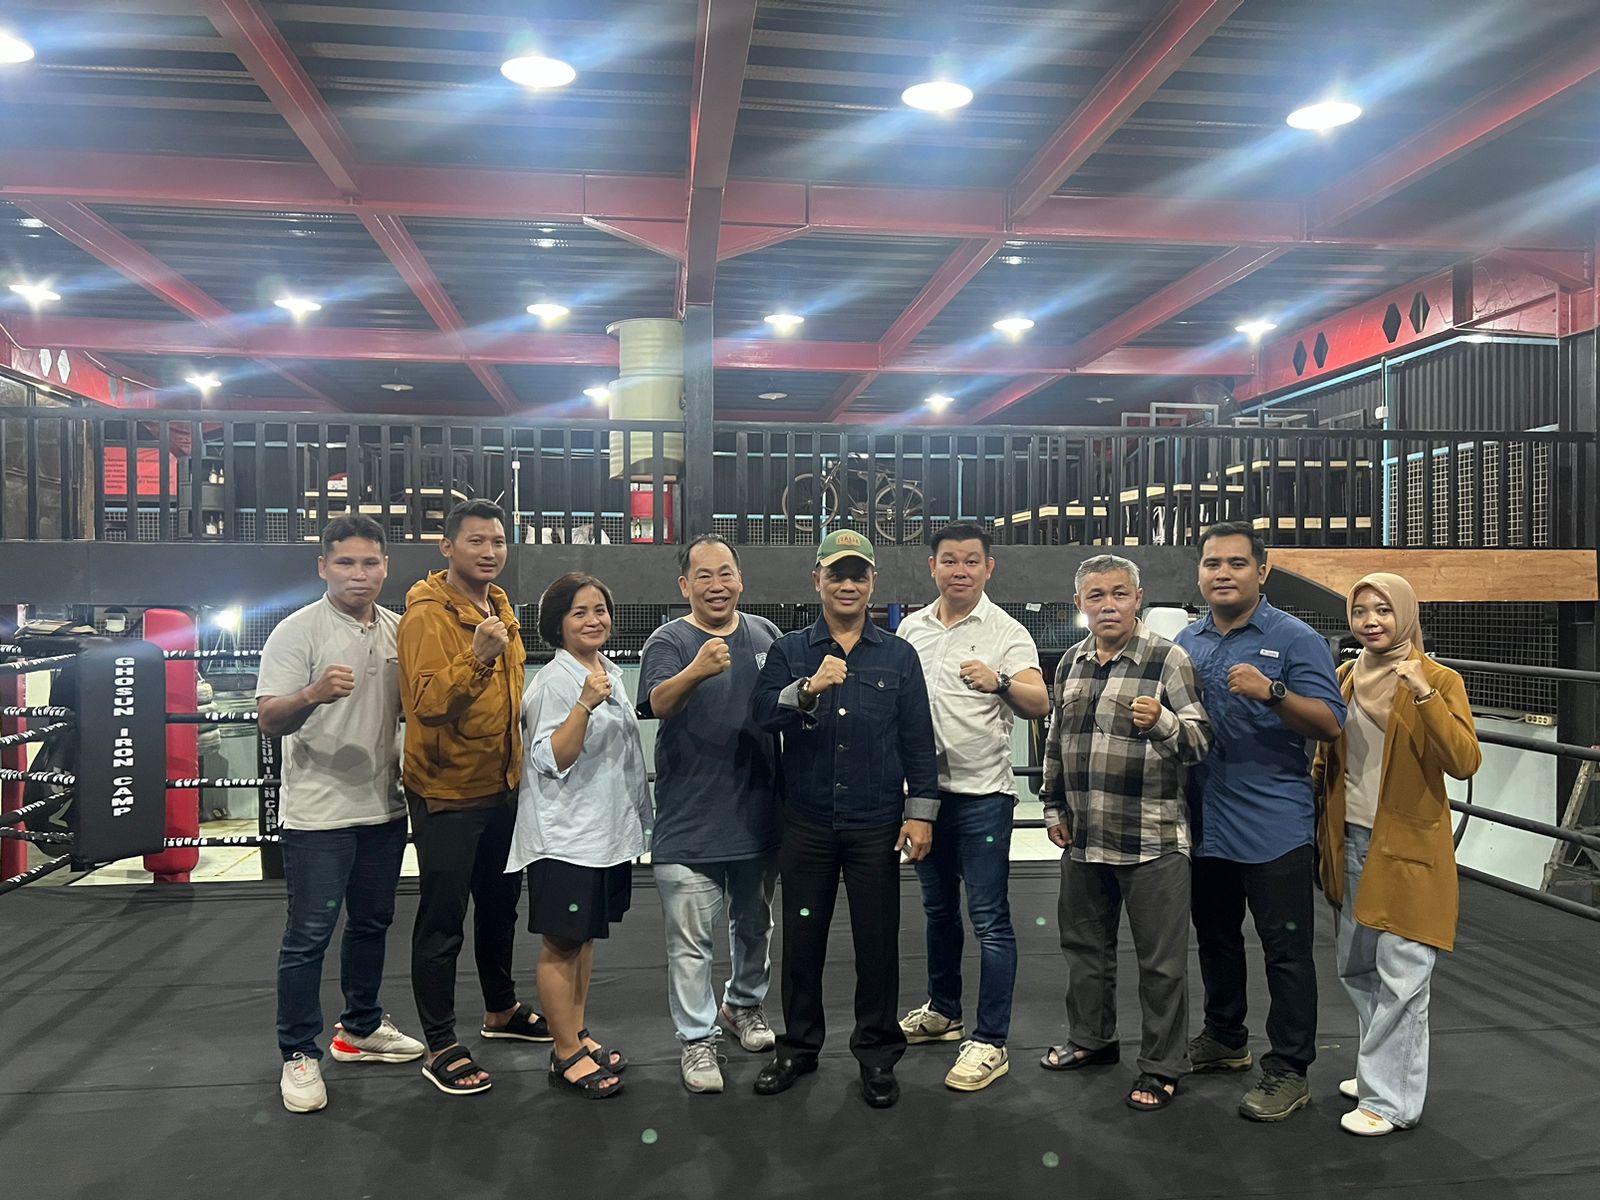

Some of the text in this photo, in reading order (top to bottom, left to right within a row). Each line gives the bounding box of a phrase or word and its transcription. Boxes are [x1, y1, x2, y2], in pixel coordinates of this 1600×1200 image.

[111, 657, 136, 817] GHOSUN IRON CAMP
[264, 766, 276, 798] IRN
[264, 800, 277, 832] CAMP
